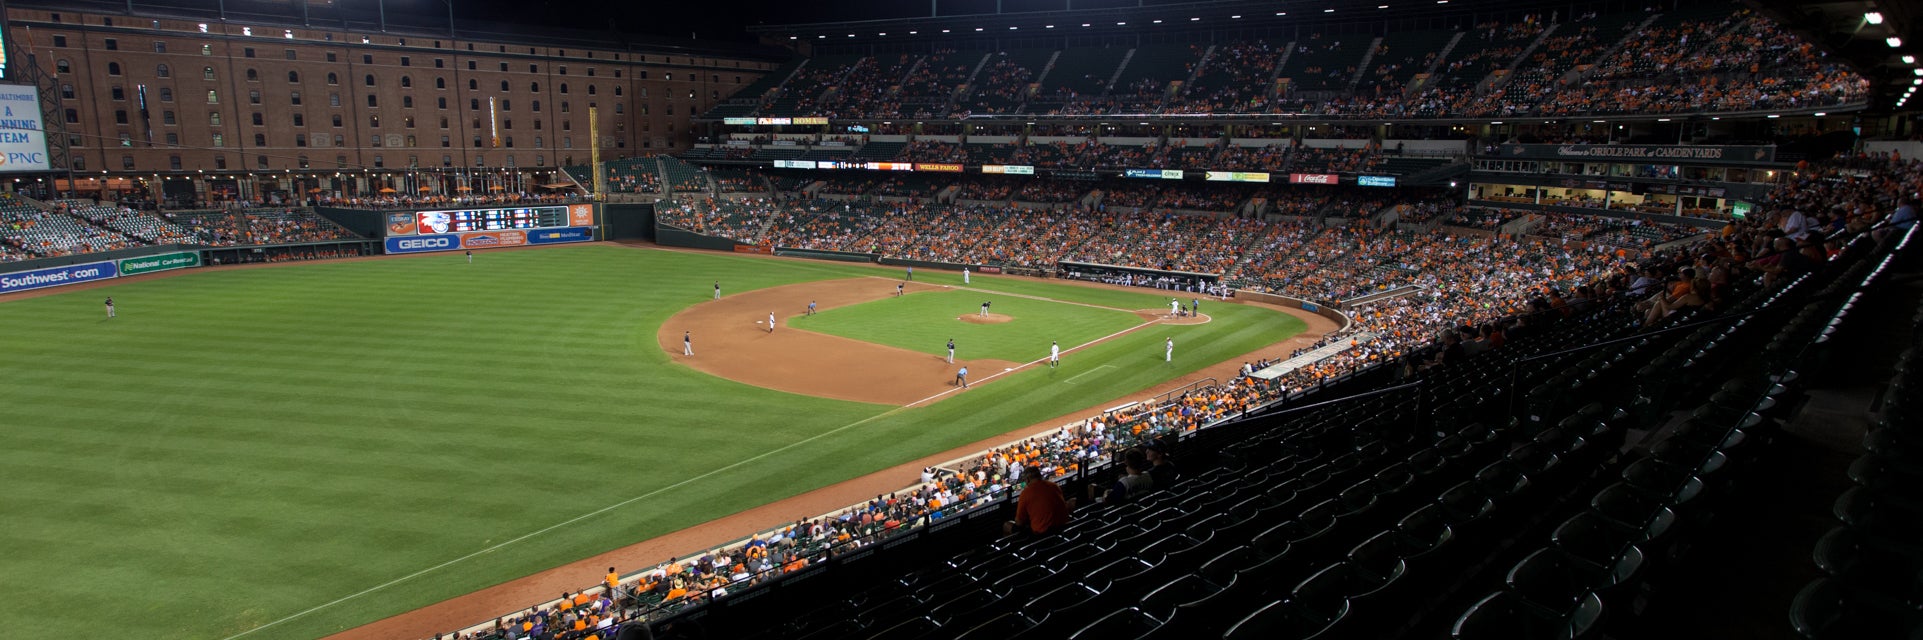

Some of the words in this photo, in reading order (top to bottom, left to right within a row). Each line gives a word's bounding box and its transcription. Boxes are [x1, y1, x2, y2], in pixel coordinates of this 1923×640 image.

[5, 105, 13, 116] A
[0, 119, 37, 130] NNING
[1557, 145, 1583, 156] Welcome
[1590, 147, 1623, 156] ORIOLE
[1623, 147, 1648, 157] PARK
[1655, 147, 1693, 158] CAMDEN
[1693, 148, 1723, 159] YARDS
[8, 152, 43, 164] PNC
[399, 237, 449, 249] GEICO
[133, 260, 160, 269] National
